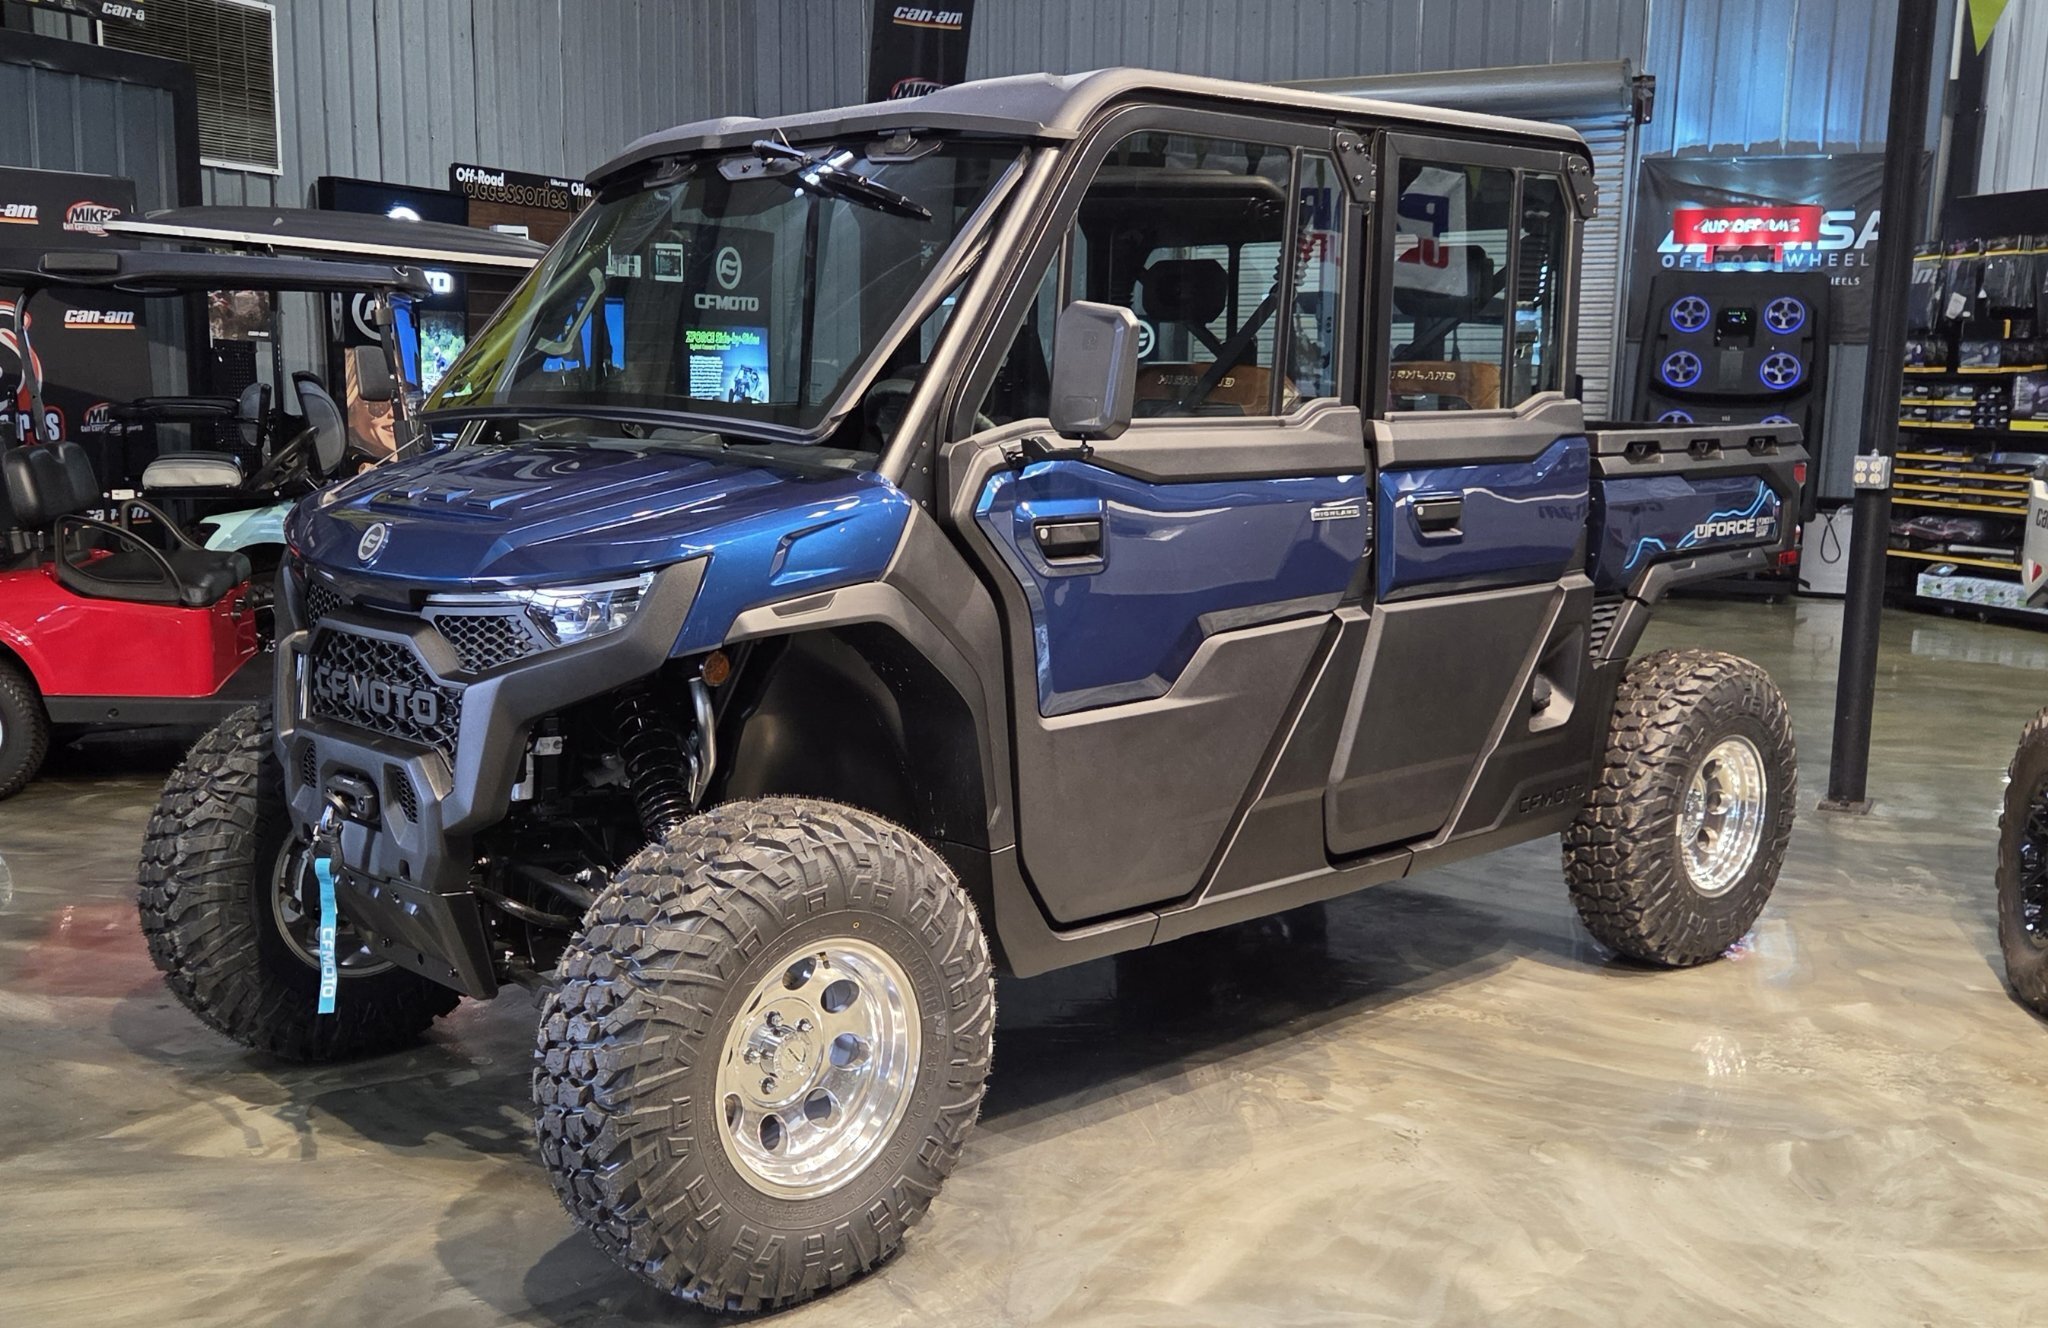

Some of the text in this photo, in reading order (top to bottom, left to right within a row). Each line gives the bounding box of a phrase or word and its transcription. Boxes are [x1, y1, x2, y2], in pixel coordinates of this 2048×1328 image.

[893, 6, 963, 25] can-am
[455, 167, 505, 187] Off-Road
[571, 181, 584, 196] Oil
[694, 293, 760, 312] CFMOTO
[64, 309, 134, 324] can-am
[1694, 518, 1756, 539] UFORCE
[315, 667, 440, 725] CFMOTO
[321, 926, 336, 999] CFMOTO
